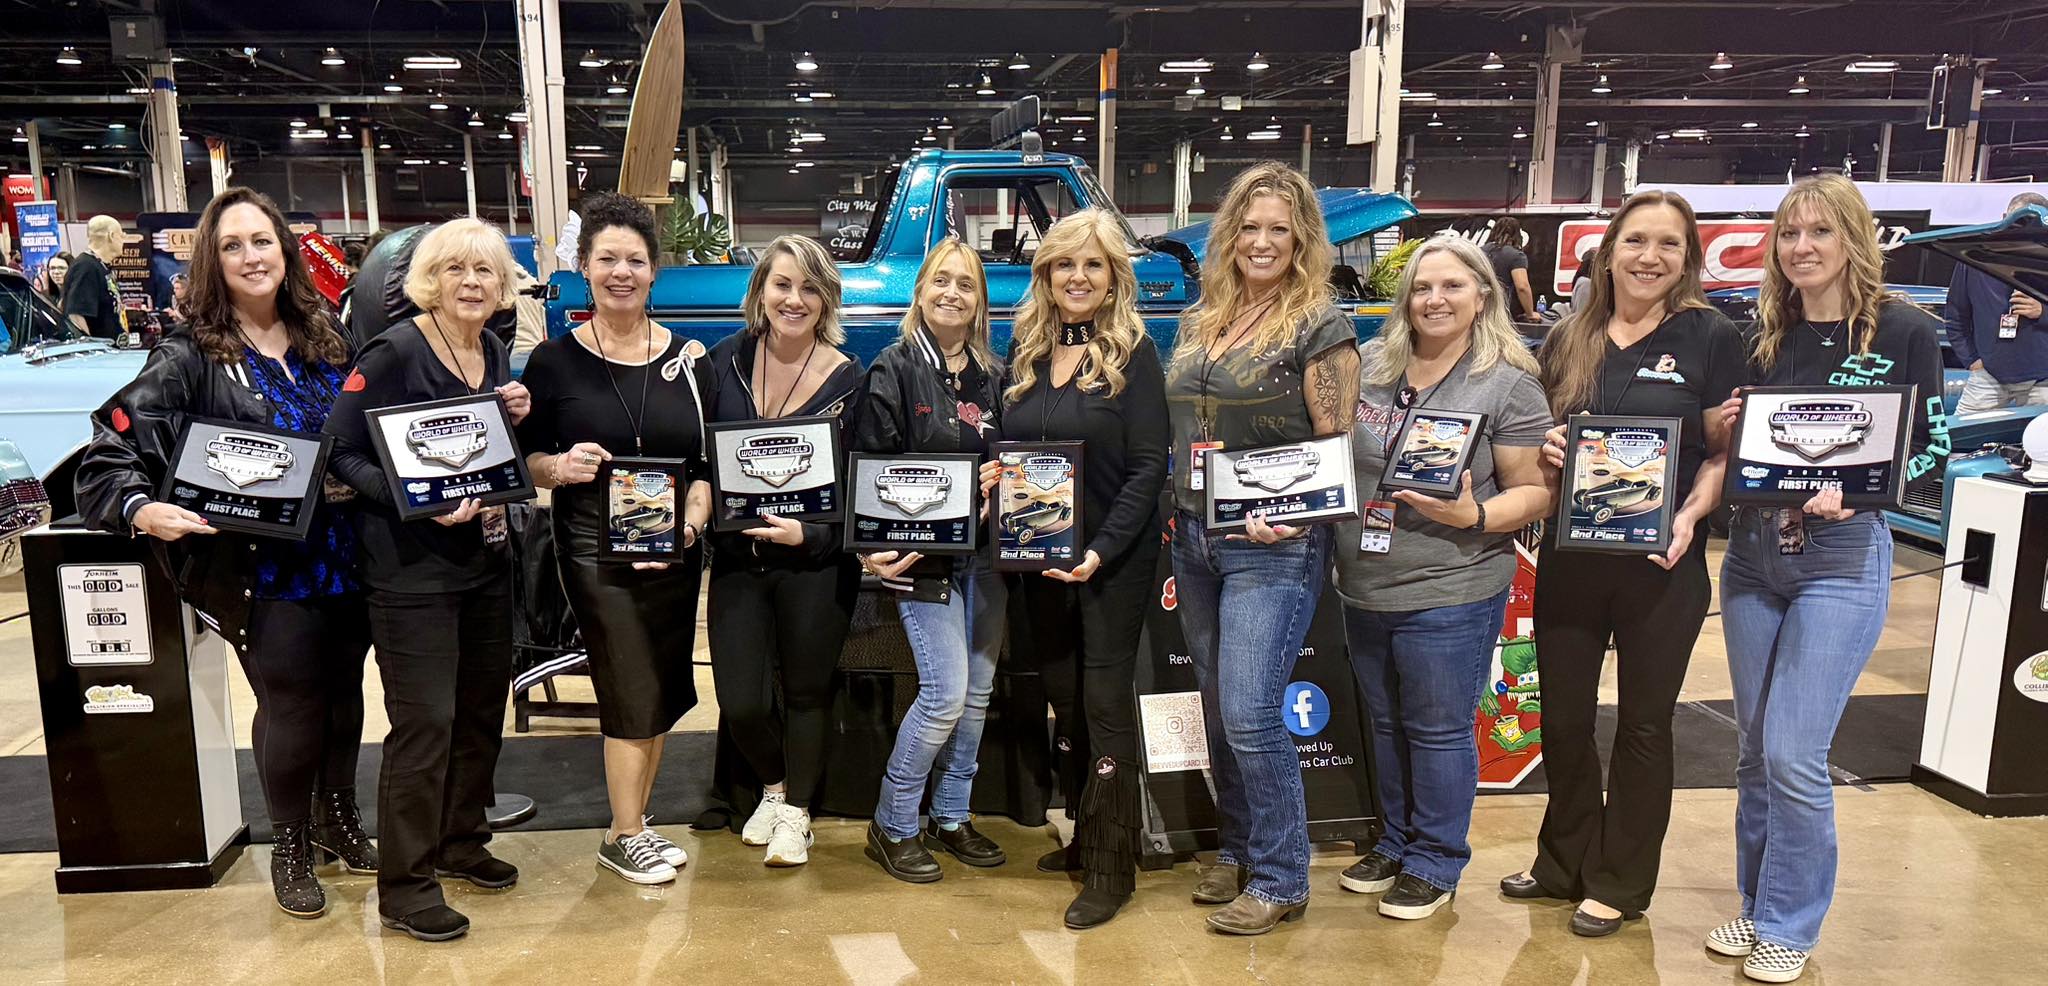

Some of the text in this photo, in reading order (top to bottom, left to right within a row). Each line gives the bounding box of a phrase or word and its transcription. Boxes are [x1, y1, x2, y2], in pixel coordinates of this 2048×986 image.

[827, 200, 879, 213] City Wid
[1773, 413, 1809, 421] WORLD
[1822, 413, 1865, 421] WHEELS
[442, 482, 492, 499] FIRST PLACE
[1777, 480, 1843, 490] FIRST PLACE
[204, 502, 261, 519] FIRST PLACE
[756, 503, 805, 515] FIRST PLACE
[1278, 502, 1308, 513] PLACE
[887, 532, 936, 541] FIRST PLACE
[1570, 529, 1625, 540] 2nd Place
[1320, 741, 1334, 753] Up
[1313, 757, 1329, 767] Car
[1331, 755, 1354, 766] Club
